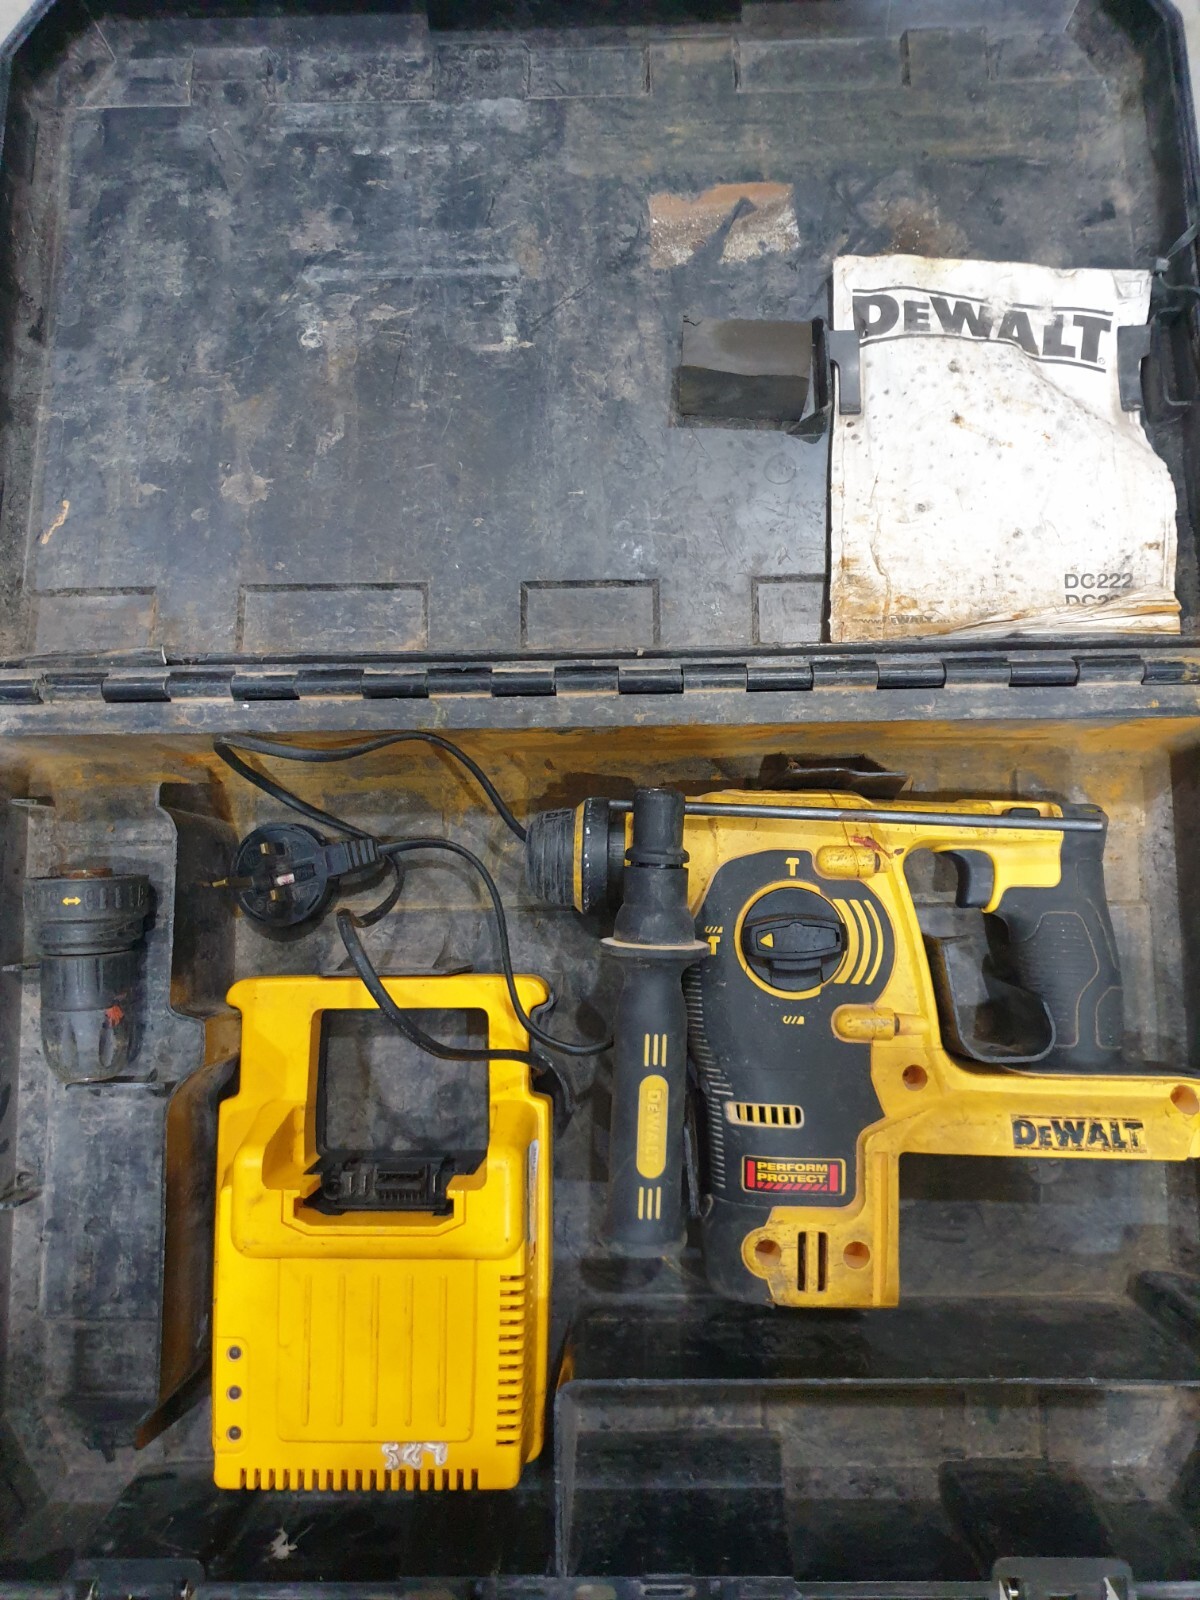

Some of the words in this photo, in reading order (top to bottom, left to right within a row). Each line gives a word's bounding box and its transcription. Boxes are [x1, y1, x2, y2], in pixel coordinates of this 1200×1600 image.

[852, 293, 1113, 364] DEWALT
[1064, 572, 1133, 589] DC222
[645, 1088, 662, 1164] DEWALT
[1012, 1118, 1145, 1149] DEWALT
[757, 1161, 828, 1172] PERFORM
[757, 1172, 826, 1183] PROTECT
